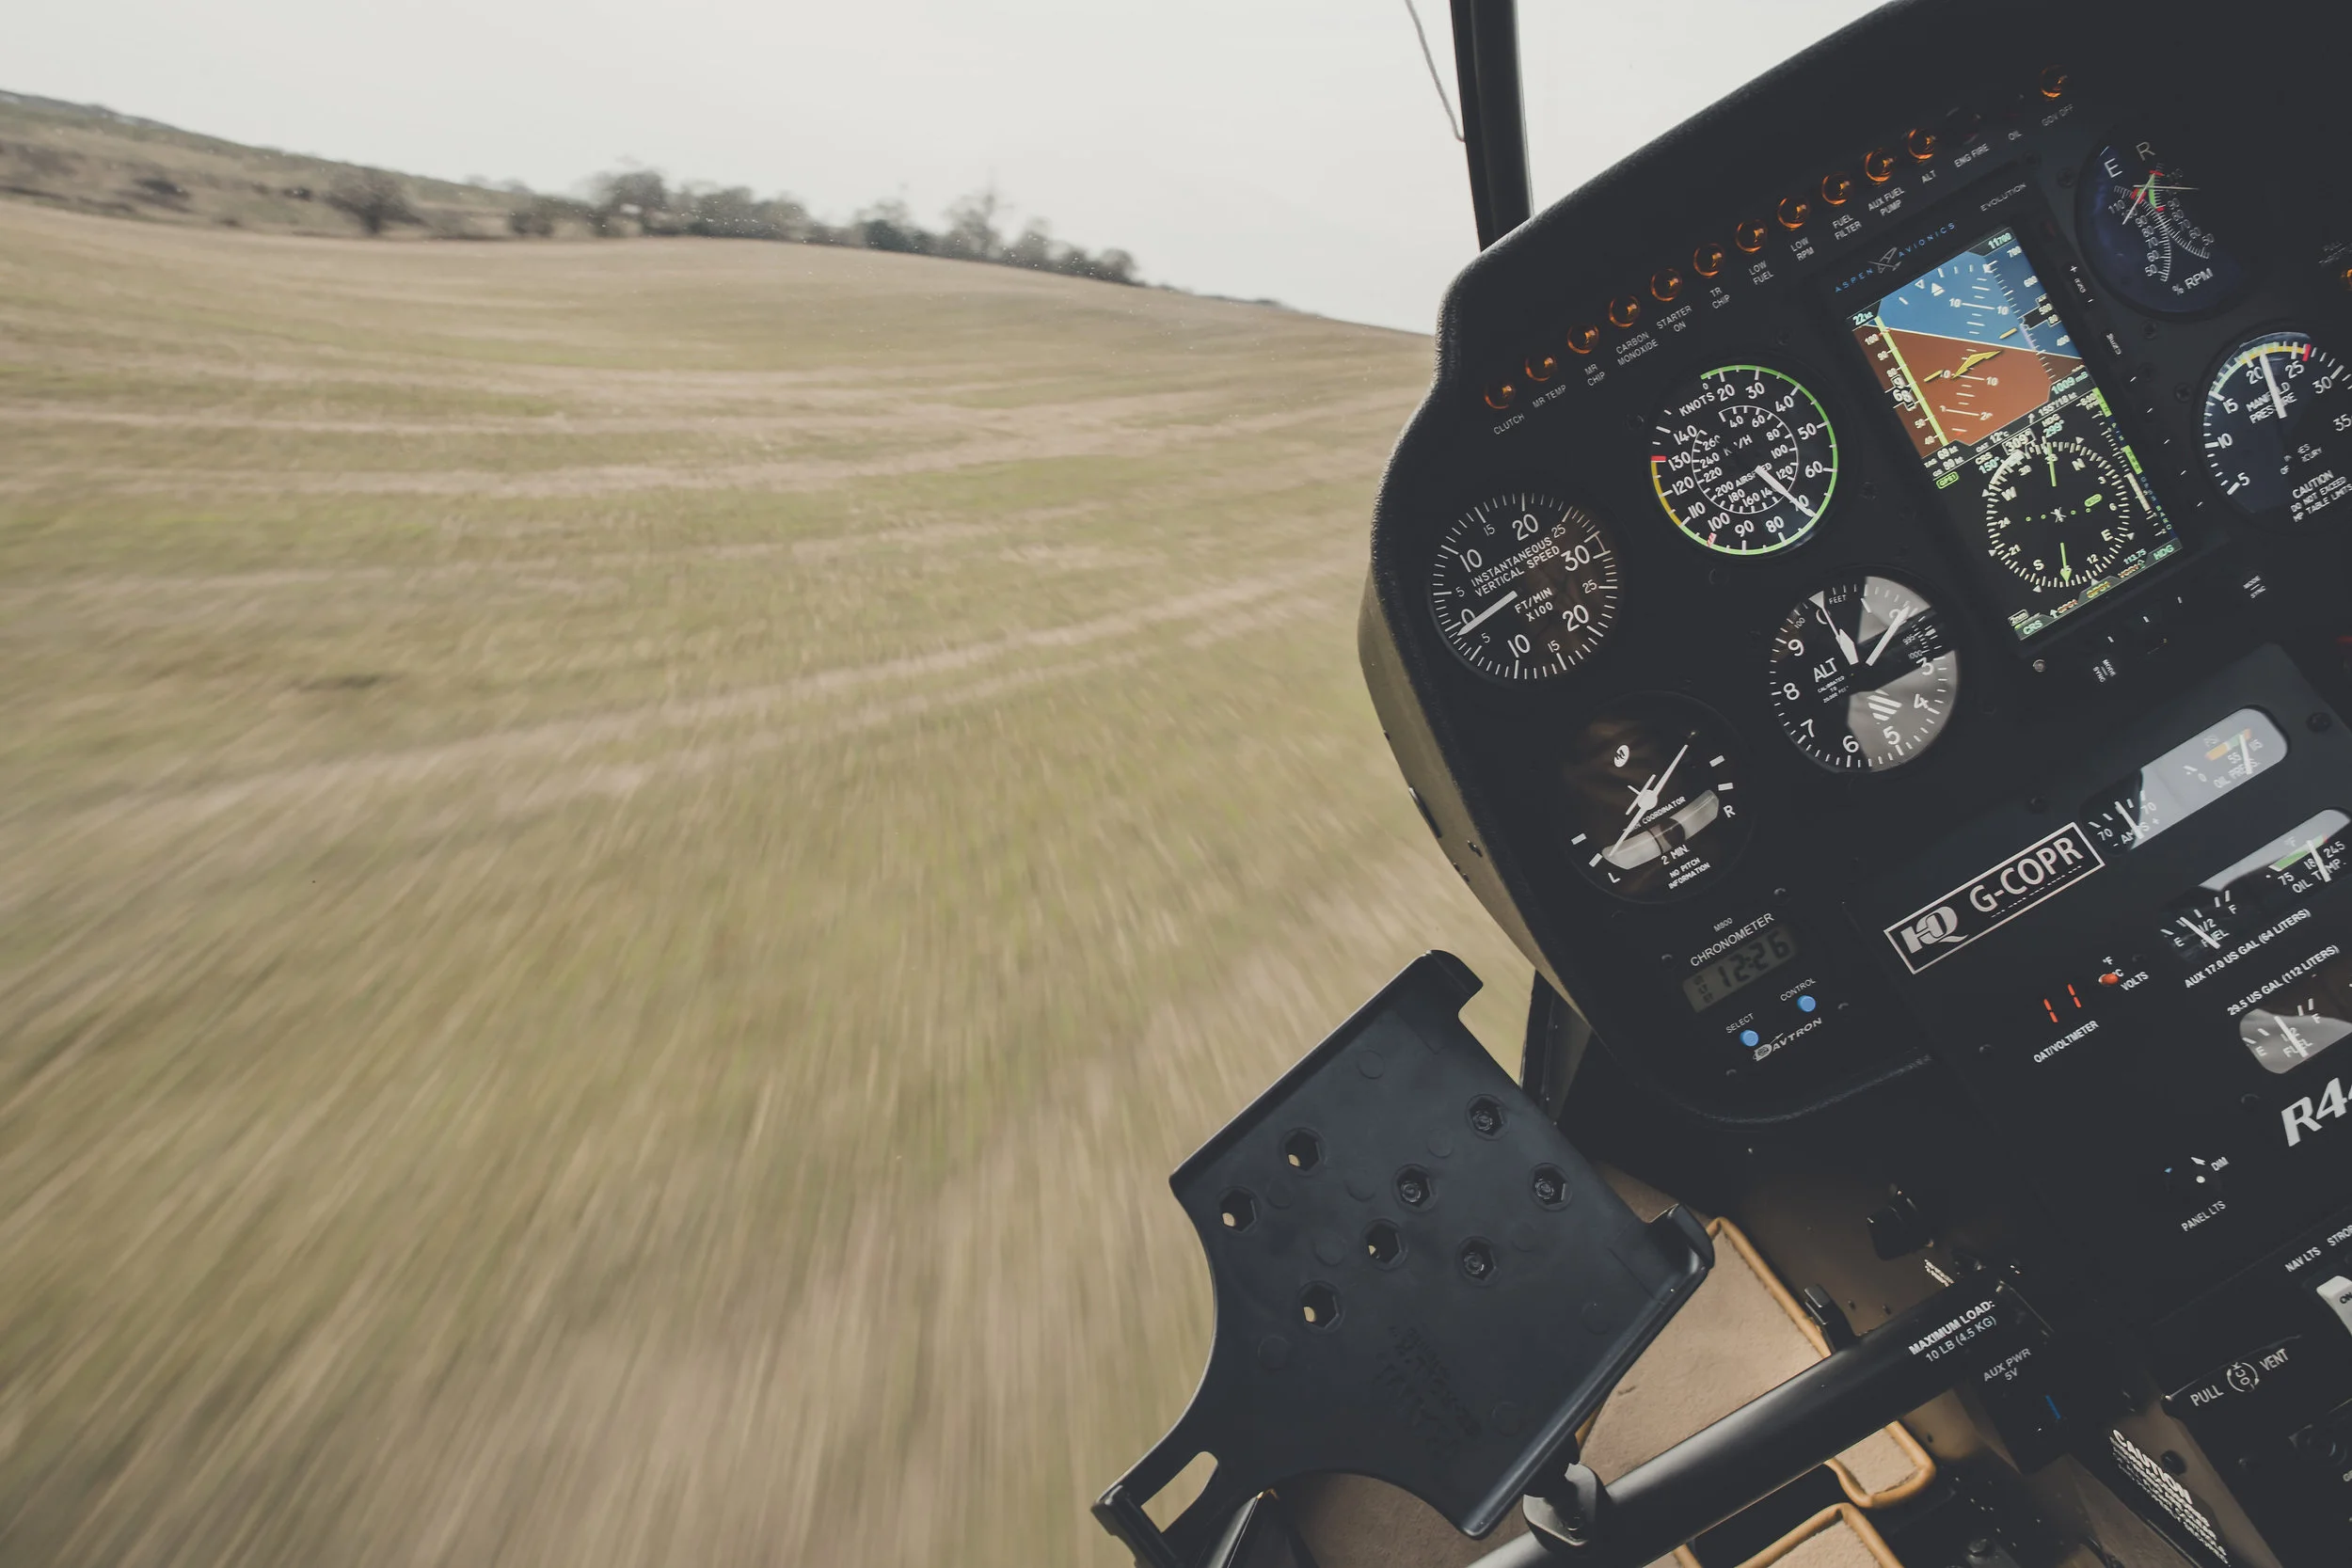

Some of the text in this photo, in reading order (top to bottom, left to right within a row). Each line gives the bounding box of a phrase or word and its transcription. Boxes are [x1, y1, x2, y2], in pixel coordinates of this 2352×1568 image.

[2008, 130, 2023, 141] OIL
[1954, 143, 1990, 167] ENG FIRE
[2136, 141, 2155, 161] R
[1921, 170, 1937, 183] ALT
[2104, 158, 2122, 178] E
[1867, 186, 1905, 212] AUX FUEL
[1979, 182, 2026, 212] EVOLUTION
[1880, 199, 1902, 216] PUMP
[1832, 214, 1853, 229] FUEL
[1835, 220, 1863, 240] FILTER
[1790, 236, 1809, 252] LOW
[1796, 246, 1815, 261] RPM
[1836, 222, 1956, 293] ASPEN AVIONICS
[1749, 261, 1767, 276] LOW
[1753, 270, 1774, 285] FUEL
[2184, 267, 2214, 290] RPM
[1709, 286, 1723, 297] TR
[1712, 294, 1731, 309] CHIP
[1949, 298, 1962, 308] 10
[1996, 306, 2010, 315] 10
[1657, 305, 1692, 329] STARTER
[1673, 321, 1687, 333] ON
[1615, 331, 1649, 355] CARBON
[1617, 339, 1659, 366] MONOXIDE
[1584, 363, 1598, 375] MR
[2246, 367, 2265, 385] 20
[2285, 360, 2305, 379] 25
[1587, 372, 1605, 387] CHIP
[2052, 377, 2075, 395] 1009
[2312, 376, 2332, 394] 30
[1533, 385, 1566, 408] MR TEMP
[1717, 383, 1735, 402] 20
[1745, 382, 1765, 399] 30
[1678, 391, 1715, 417] KNOTS
[1775, 395, 1794, 412] 40
[2222, 398, 2239, 414] 15
[1493, 414, 1525, 435] CLUTCH
[1729, 415, 1743, 429] 40
[1752, 415, 1766, 428] 60
[2333, 413, 2352, 432] 35
[1674, 425, 1697, 445] 140
[1766, 428, 1780, 441] 80
[1798, 422, 1817, 440] 50
[2217, 433, 2233, 449] 10
[1700, 451, 1720, 468] 240
[1771, 444, 1788, 459] 100
[1975, 451, 1993, 466] CRS
[1668, 451, 1692, 471] 130
[1805, 461, 1823, 479] 60
[2071, 457, 2086, 471] N
[1704, 467, 1723, 483] 220
[1775, 465, 1793, 481] 120
[2237, 472, 2250, 486] 5
[1672, 476, 1694, 496] 120
[1715, 481, 1734, 498] 200
[2292, 470, 2334, 499] CAUTION
[1727, 489, 1745, 503] 180
[1743, 493, 1760, 507] 160
[2001, 486, 2017, 502] W
[2290, 476, 2347, 513] DO NOT EXCEED
[1688, 501, 1706, 519] 110
[2305, 497, 2330, 515] TABLE
[1484, 524, 1496, 537] 15
[1512, 514, 1539, 541] 20
[1708, 512, 1730, 531] 100
[1735, 519, 1755, 537] 90
[1765, 515, 1785, 533] 80
[1551, 524, 1566, 538] 25
[2101, 529, 2113, 542] E
[1459, 548, 1483, 573] 10
[1470, 536, 1552, 588] INSTANTANEOUS
[1561, 545, 1590, 572] 30
[2087, 554, 2099, 564] 12
[2153, 545, 2174, 561] HDG
[1474, 546, 1561, 597] VERTICAL SPEED
[2033, 560, 2044, 571] S
[1455, 586, 1465, 597] 5
[1582, 579, 1597, 594] 25
[1514, 587, 1553, 613] FT/MIN
[1829, 594, 1848, 605] FEET
[1526, 601, 1554, 623] X100
[1562, 604, 1590, 632] 20
[1794, 617, 1806, 629] 100
[2023, 620, 2042, 635] CRS
[1481, 632, 1491, 643] 5
[1507, 634, 1531, 658] 10
[1547, 640, 1560, 653] 15
[1788, 639, 1804, 657] 9
[1813, 657, 1837, 683] ALT
[1915, 657, 1934, 675] 3
[1783, 682, 1800, 701] 8
[1817, 675, 1845, 693] CALIBRATED
[1914, 693, 1930, 709] 4
[1800, 719, 1815, 738] 7
[1883, 726, 1900, 745] 5
[1843, 735, 1860, 752] 6
[2213, 776, 2232, 788] OIL
[1642, 796, 1686, 824] COORDINATOR
[1724, 804, 1736, 818] R
[2097, 828, 2114, 841] 70
[2323, 841, 2346, 859] 245
[1661, 855, 1670, 865] 2
[1669, 857, 1701, 879] NO PITCH
[1608, 872, 1621, 884] L
[1668, 862, 1711, 890] INFORMATION
[1969, 837, 2084, 912] G-COPR
[2278, 872, 2296, 886] 75
[2292, 879, 2313, 894] OIL
[2228, 904, 2238, 915] F
[1713, 917, 1733, 932] M800
[1690, 912, 1774, 967] CHRONOMETER
[2173, 937, 2185, 947] E
[2185, 909, 2312, 989] AUX 17.0 US GAL (64 LITERS)
[1717, 929, 1790, 988] 12:26
[2120, 971, 2150, 991] VOLTS
[2227, 944, 2341, 1016] 29.5 US GAL (112 LITERS)
[1780, 977, 1817, 1002] CONTROL
[1725, 1012, 1755, 1034] SELECT
[2312, 1013, 2322, 1024] F
[1753, 1018, 1822, 1062] DAVTRON
[2033, 1020, 2100, 1063] OAT/VOLTMETER
[2256, 1046, 2268, 1057] E
[2280, 1077, 2352, 1148] R4
[2211, 1156, 2230, 1171] DIM
[2181, 1200, 2227, 1231] PANEL LTS
[2284, 1246, 2322, 1273] NAV LTS
[1908, 1300, 1995, 1355] MAXIMUM LOAD:
[1926, 1315, 1996, 1363] 10 LB (4.5 KG)
[1983, 1348, 2032, 1382] AUX PWR
[2004, 1367, 2018, 1381] 5V
[2189, 1348, 2289, 1407] PULL VENT
